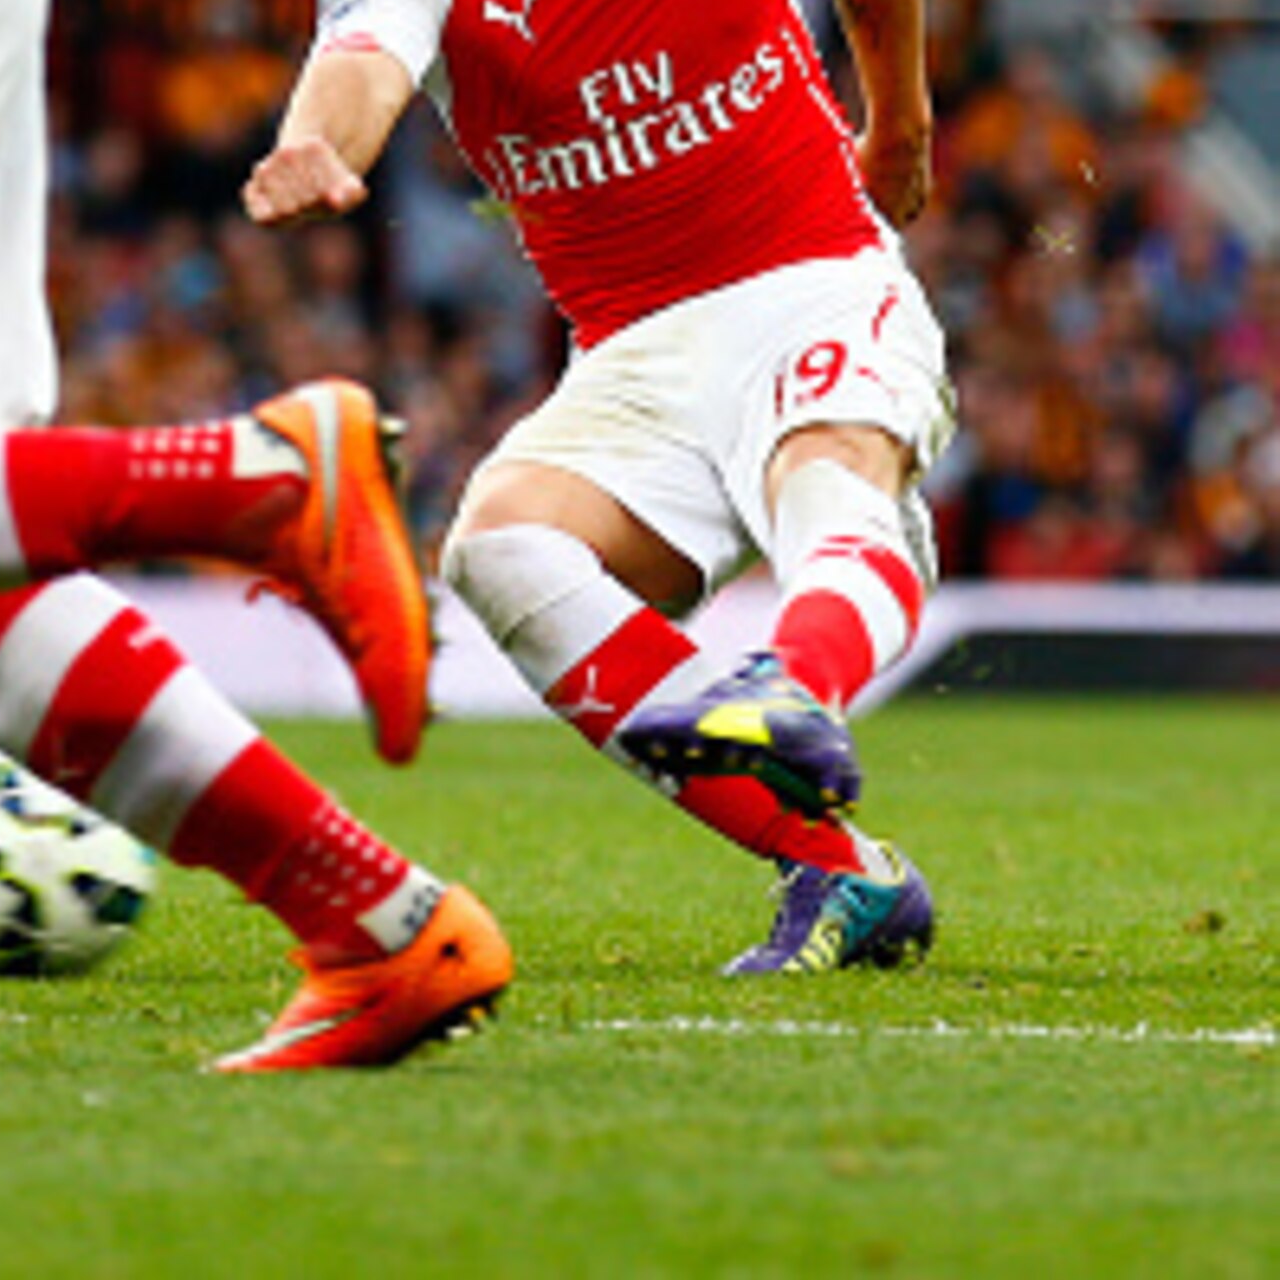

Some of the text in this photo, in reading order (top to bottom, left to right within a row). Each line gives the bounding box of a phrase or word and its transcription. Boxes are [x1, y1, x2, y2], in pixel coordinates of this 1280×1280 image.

[496, 42, 784, 195] Emirates
[579, 50, 674, 122] Fly
[773, 338, 849, 418] 19
